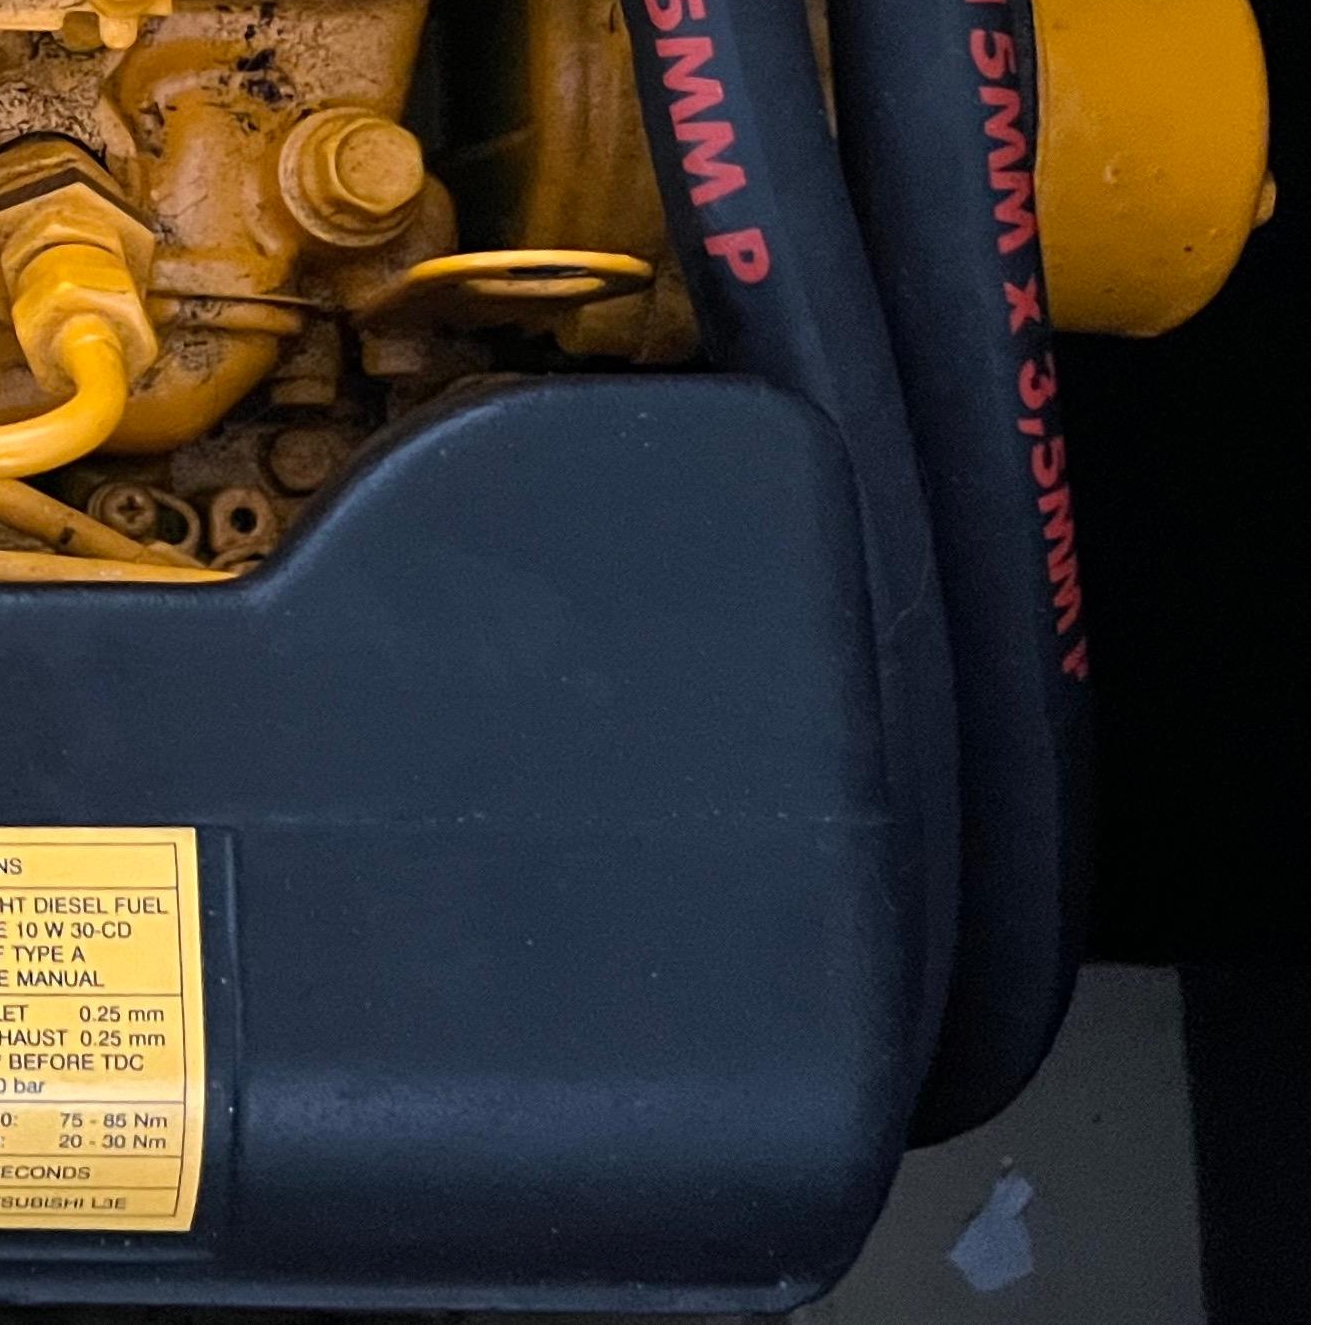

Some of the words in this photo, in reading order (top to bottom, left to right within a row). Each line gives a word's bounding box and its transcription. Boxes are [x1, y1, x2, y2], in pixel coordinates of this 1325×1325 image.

[702, 227, 773, 288] P
[1000, 270, 1043, 335] x
[34, 896, 108, 915] DIESEL
[114, 896, 169, 915] FUEL
[17, 921, 38, 939] 10
[44, 921, 64, 939] W
[70, 921, 132, 939] 30-CD
[12, 945, 64, 963] TYPE
[71, 945, 86, 963] A
[16, 970, 105, 988] MANUAL
[79, 1005, 121, 1023] 0.25
[128, 1009, 165, 1022] mm
[79, 1030, 122, 1047] 0.25
[128, 1033, 166, 1047] mm
[8, 1053, 94, 1071] BEFORE
[101, 1053, 144, 1072] TDC
[13, 1076, 46, 1094] bar
[60, 1112, 83, 1129] 75
[134, 1112, 168, 1129] Nm
[58, 1134, 83, 1149] 20
[101, 1134, 127, 1149] 30
[132, 1134, 167, 1149] Nm
